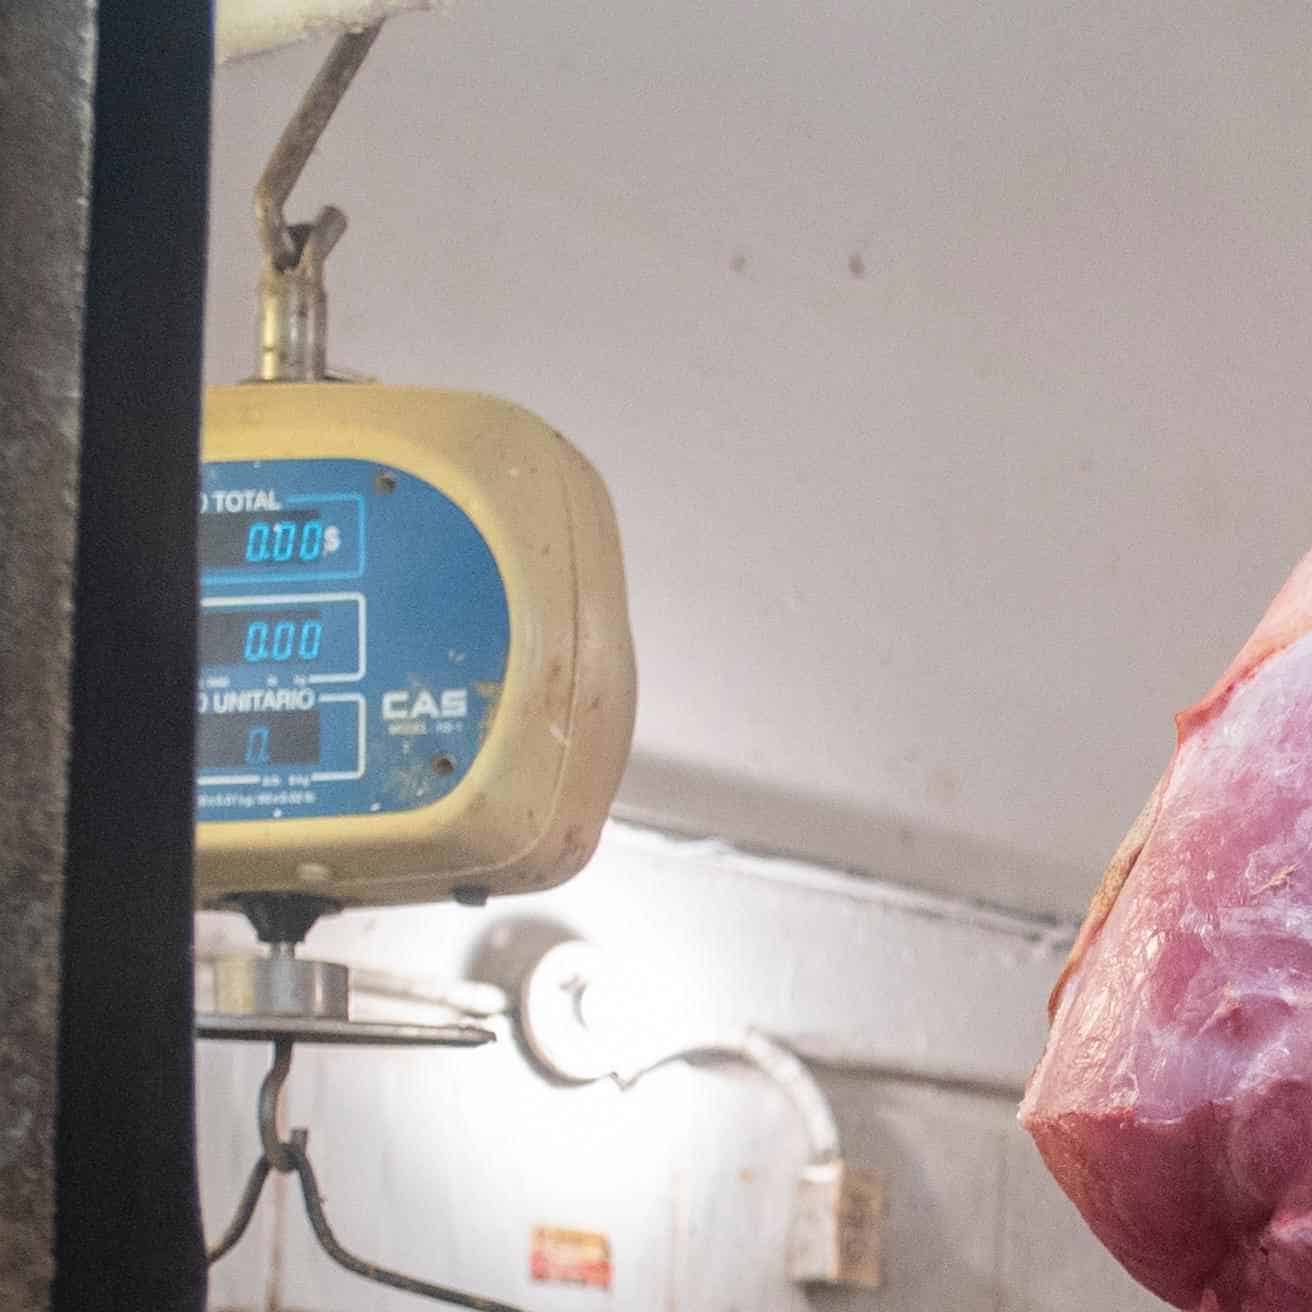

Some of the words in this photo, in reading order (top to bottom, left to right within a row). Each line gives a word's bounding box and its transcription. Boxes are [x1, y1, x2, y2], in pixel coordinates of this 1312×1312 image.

[211, 488, 282, 513] TOTAL
[213, 687, 315, 714] UNITARIO
[382, 689, 467, 720] CAS
